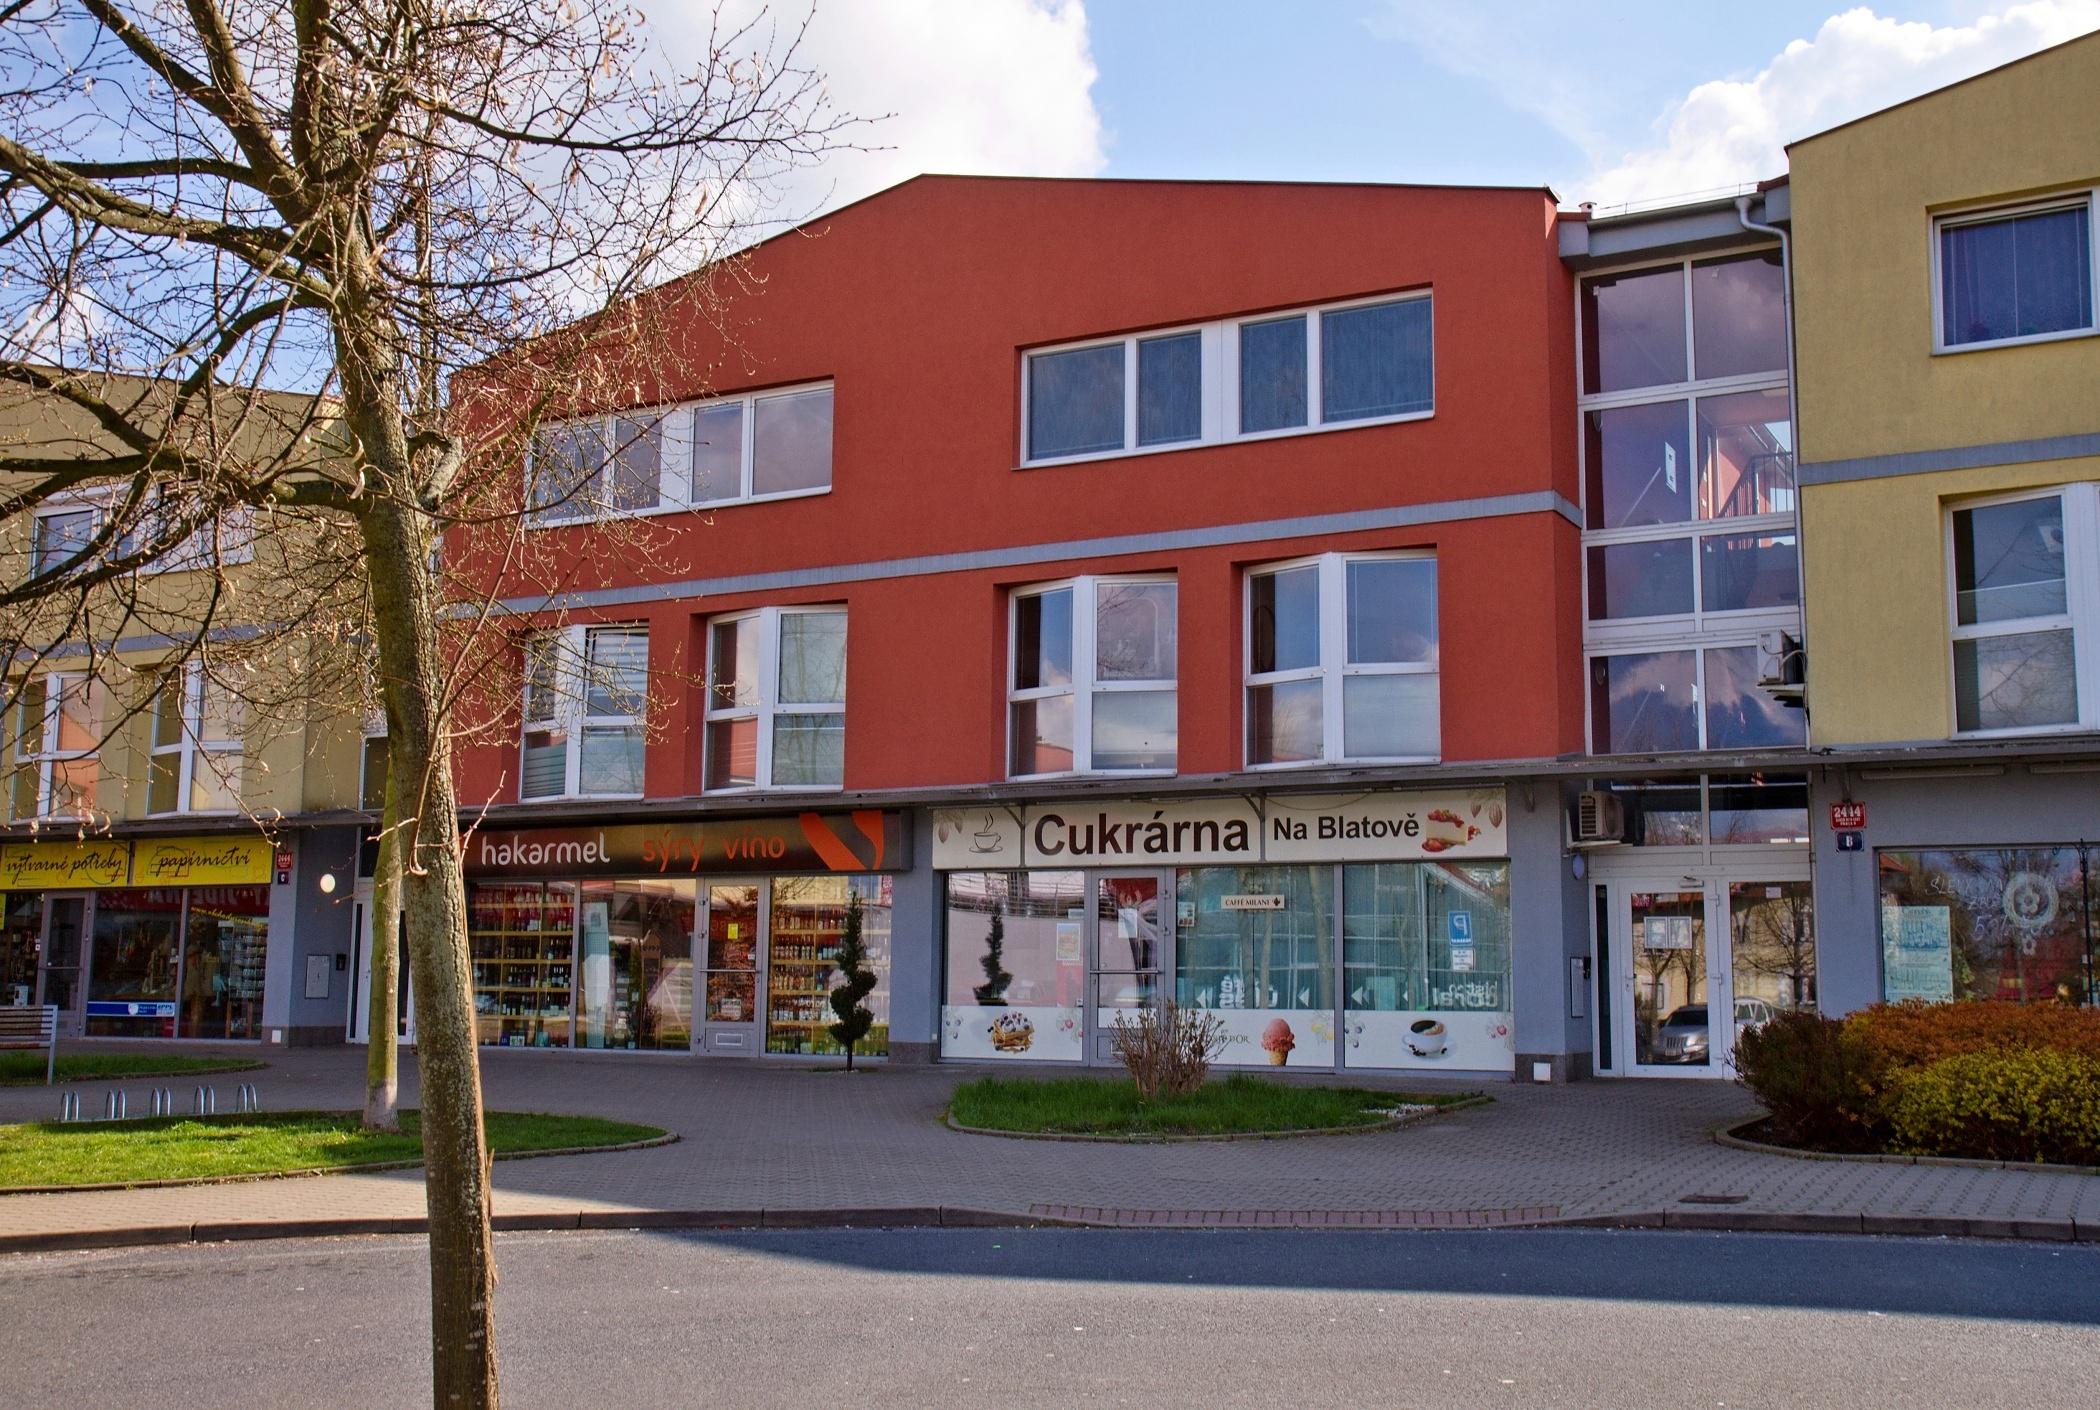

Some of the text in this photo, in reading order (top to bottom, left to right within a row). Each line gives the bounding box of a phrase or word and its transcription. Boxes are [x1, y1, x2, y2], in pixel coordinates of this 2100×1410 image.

[1273, 813, 1419, 840] Na Blatově
[1834, 805, 1861, 818] 2444
[481, 832, 610, 866] hakarmel
[643, 825, 785, 873] sýry víno
[1034, 810, 1250, 856] Cukrárna
[1846, 835, 1853, 847] B
[6, 848, 122, 885] výtvarné potřeby
[156, 846, 252, 877] papírnictví
